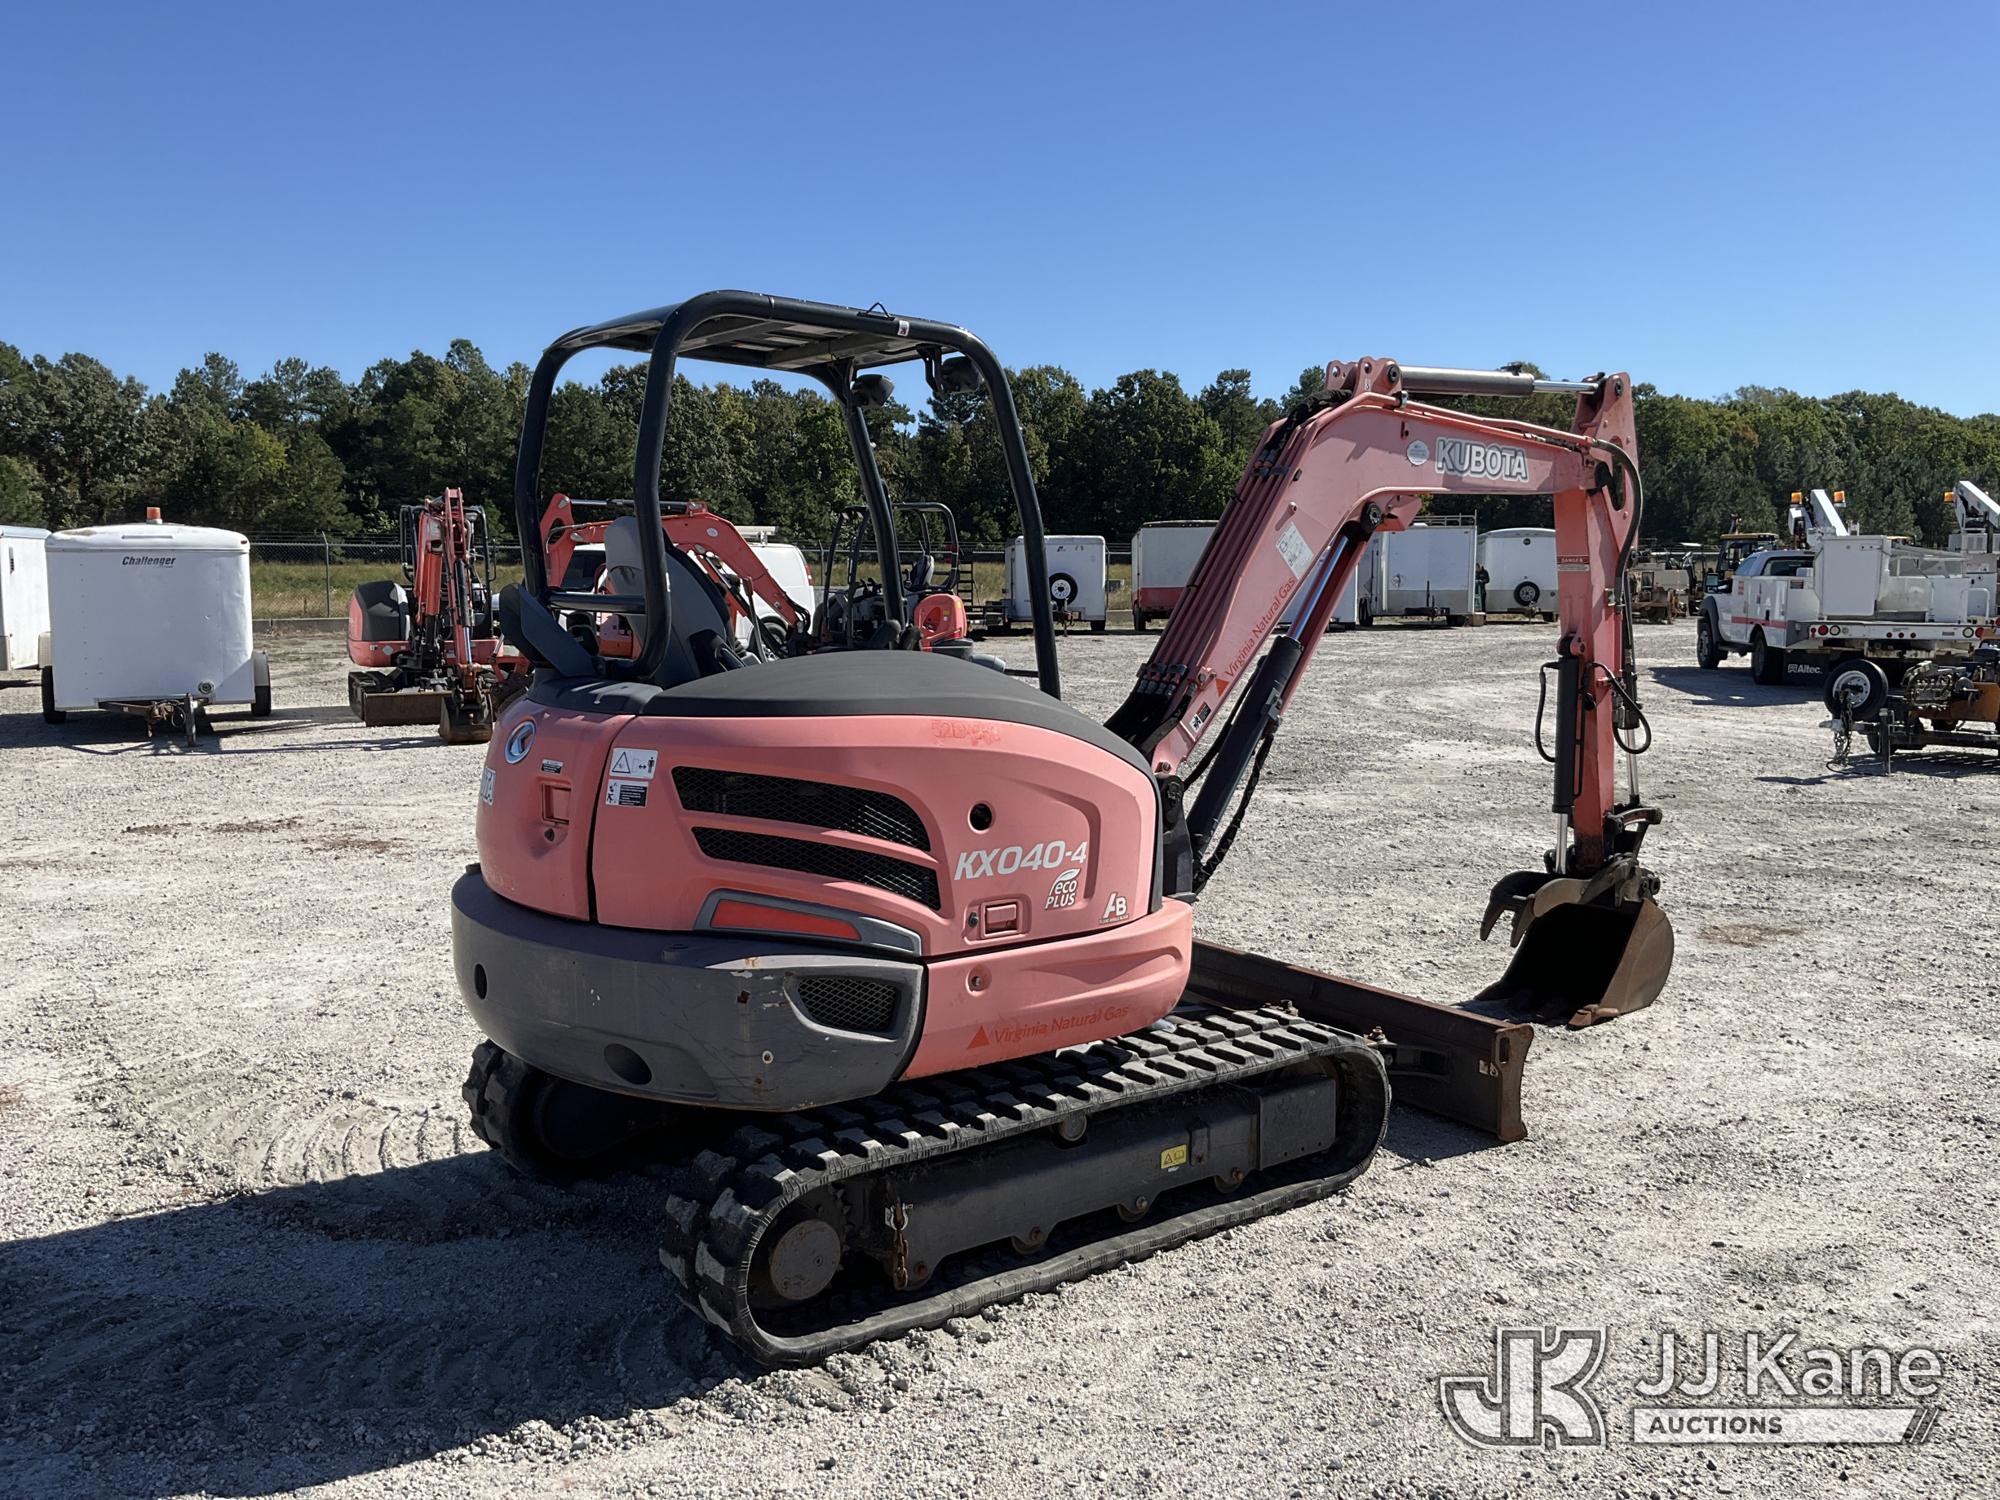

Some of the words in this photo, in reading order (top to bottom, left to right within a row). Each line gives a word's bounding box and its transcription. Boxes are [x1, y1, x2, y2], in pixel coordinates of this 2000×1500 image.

[1435, 437, 1529, 482] KUBOTA
[122, 556, 176, 566] Challenger
[1224, 637, 1255, 678] Virginia
[1252, 596, 1282, 638] Natural
[1278, 577, 1296, 601] Gas
[954, 840, 1088, 880] KX040-4
[1044, 893, 1076, 910] PLUS
[994, 1022, 1048, 1043] Virginia
[1051, 1008, 1101, 1032] Natural
[1104, 1006, 1129, 1021] Gas
